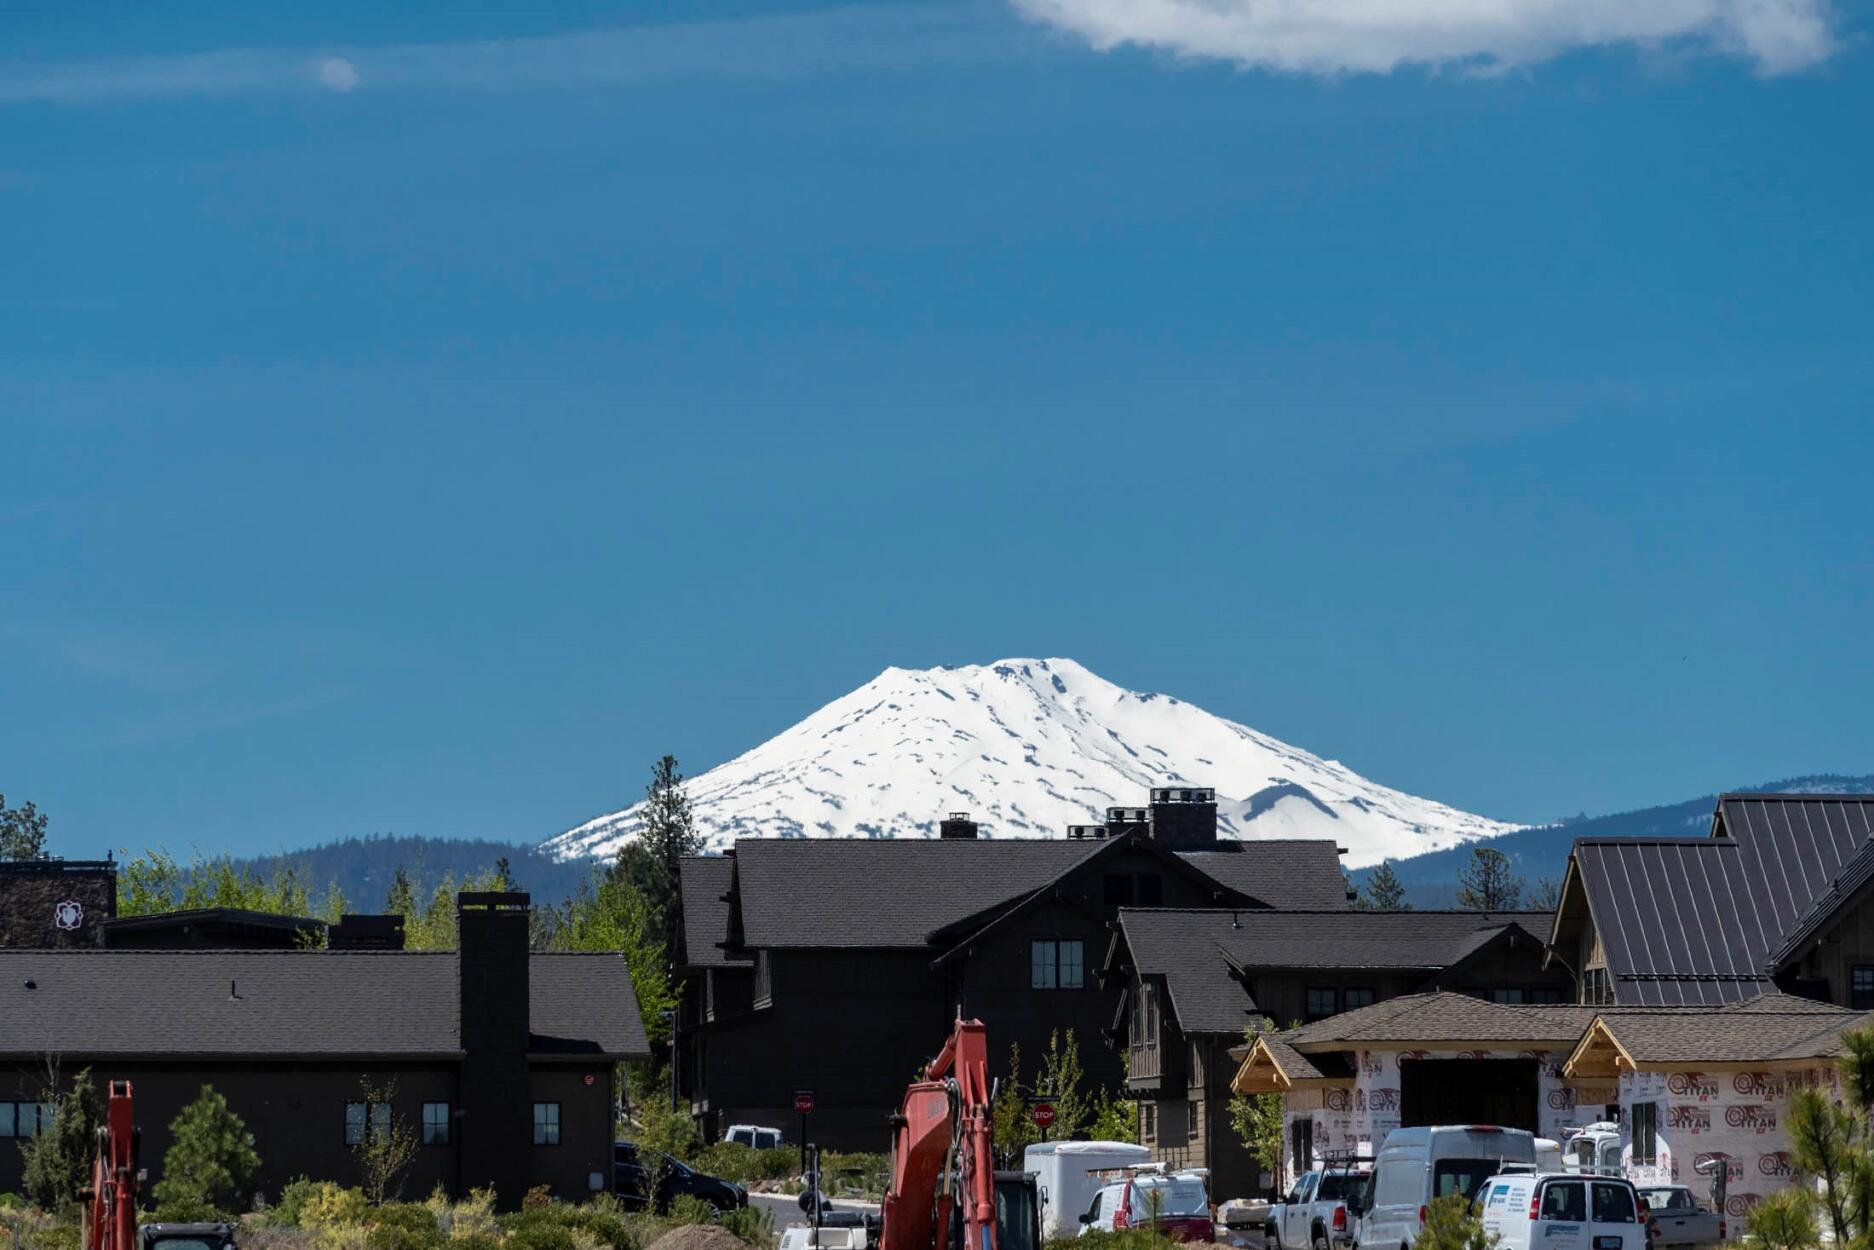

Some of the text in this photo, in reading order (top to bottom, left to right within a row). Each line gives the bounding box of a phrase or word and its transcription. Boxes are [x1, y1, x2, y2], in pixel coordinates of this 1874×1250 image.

[1681, 1086, 1719, 1096] TITAN
[1747, 1086, 1784, 1096] TITAN
[1674, 1119, 1711, 1129] TITAN
[1741, 1119, 1776, 1129] TITAN
